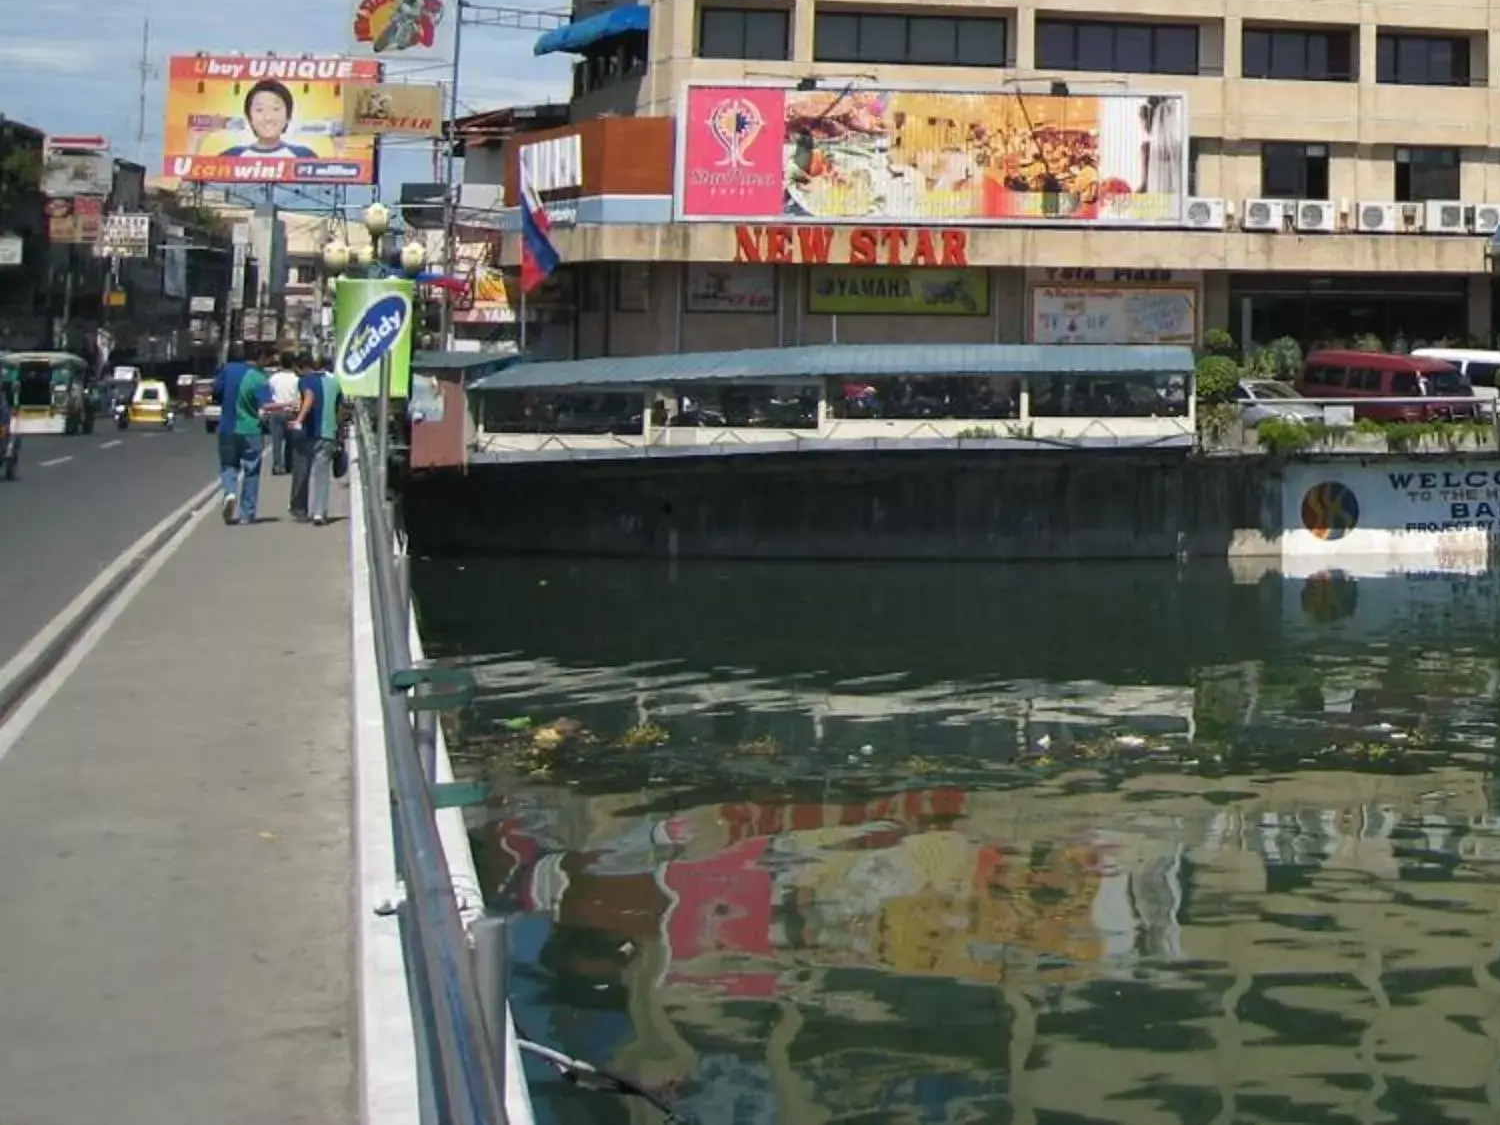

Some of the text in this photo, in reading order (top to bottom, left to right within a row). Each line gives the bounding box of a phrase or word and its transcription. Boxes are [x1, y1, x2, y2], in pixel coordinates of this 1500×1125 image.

[207, 60, 245, 79] buy
[249, 60, 353, 78] UNIQUE
[173, 156, 286, 180] U can win!
[733, 225, 968, 266] NEW STAR
[834, 275, 913, 299] YAMAHA
[1408, 490, 1432, 503] TO
[1440, 488, 1477, 502] THE
